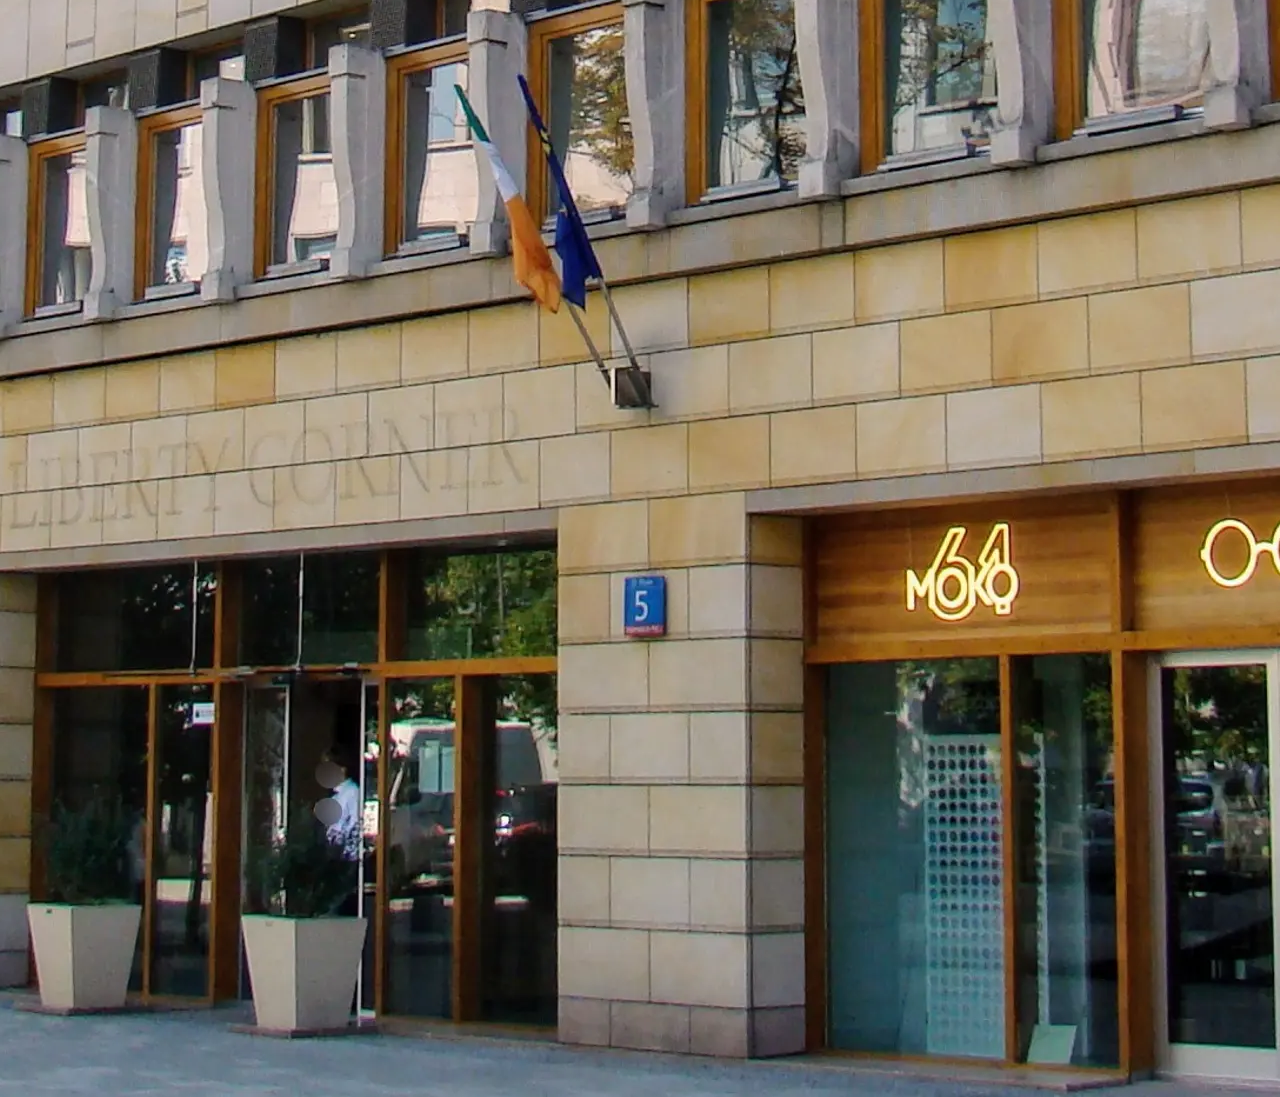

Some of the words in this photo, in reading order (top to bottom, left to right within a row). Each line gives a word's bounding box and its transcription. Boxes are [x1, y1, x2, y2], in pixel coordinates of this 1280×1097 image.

[8, 437, 230, 529] LIBERTY
[249, 404, 531, 508] CORNER
[634, 589, 649, 622] 5
